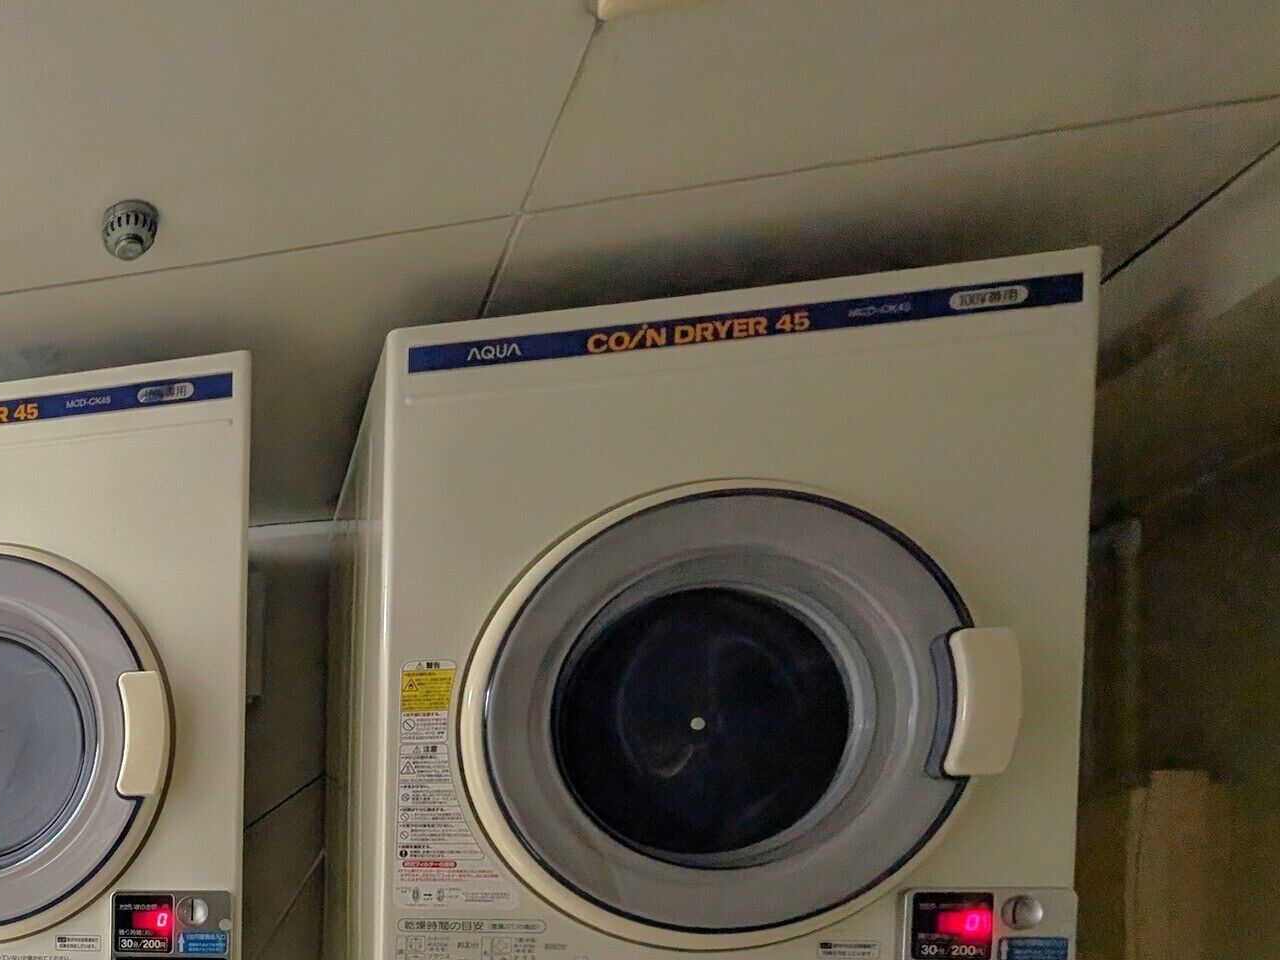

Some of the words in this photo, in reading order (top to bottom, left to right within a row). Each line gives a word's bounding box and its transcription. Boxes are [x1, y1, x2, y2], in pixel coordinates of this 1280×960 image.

[674, 316, 768, 345] DRYER
[775, 312, 811, 333] 45
[466, 343, 522, 361] AQUA
[13, 403, 39, 420] 45
[156, 912, 169, 927] 0
